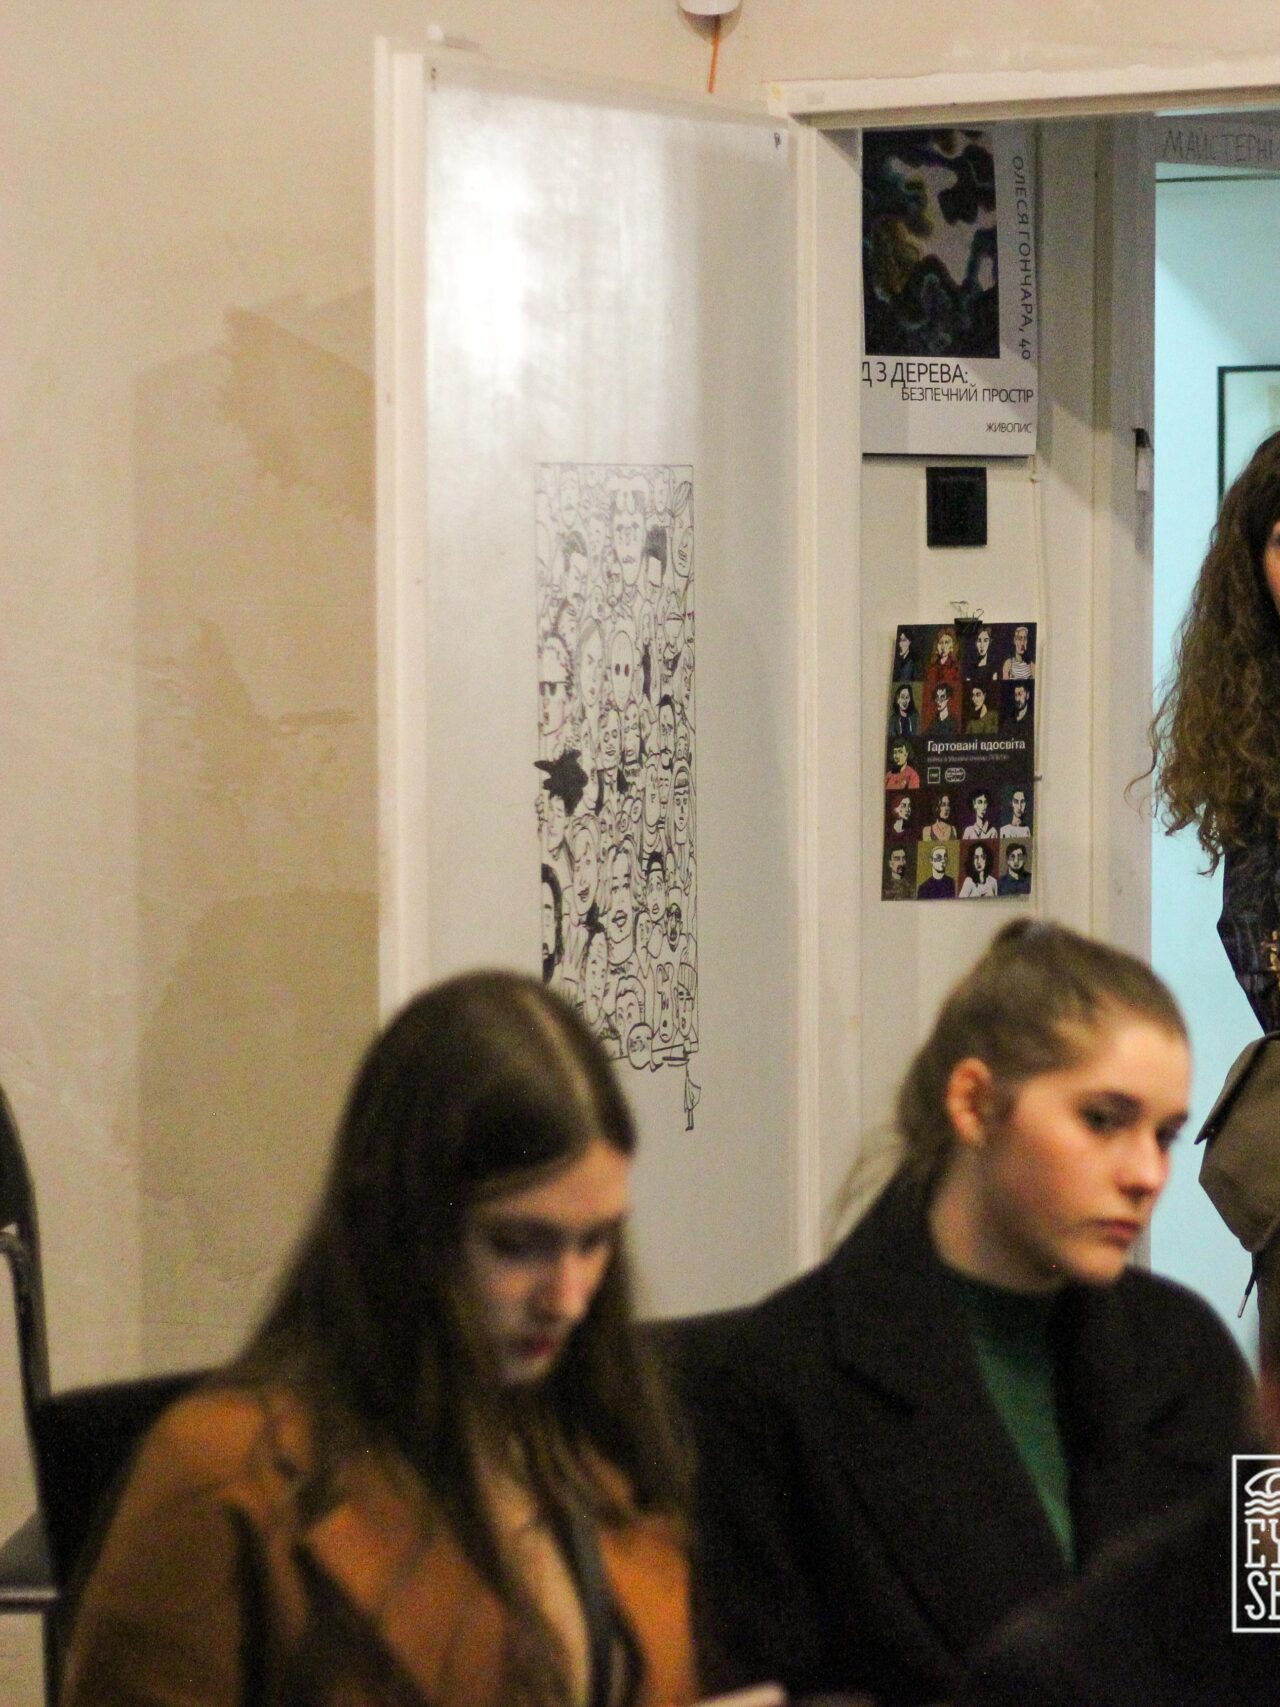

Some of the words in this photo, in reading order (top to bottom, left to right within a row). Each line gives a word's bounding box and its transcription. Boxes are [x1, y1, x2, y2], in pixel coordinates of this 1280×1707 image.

[1012, 155, 1030, 225] ОЛЕСЯ
[1018, 230, 1034, 332] ГОНЧАРА,
[890, 362, 968, 389] ДЕРЕВА:
[901, 383, 978, 402] БЕЗПЕЧНИЙ
[982, 388, 1034, 403] ПРОСТІР
[927, 739, 978, 754] Гартовані
[980, 737, 1026, 751] вдосвіта
